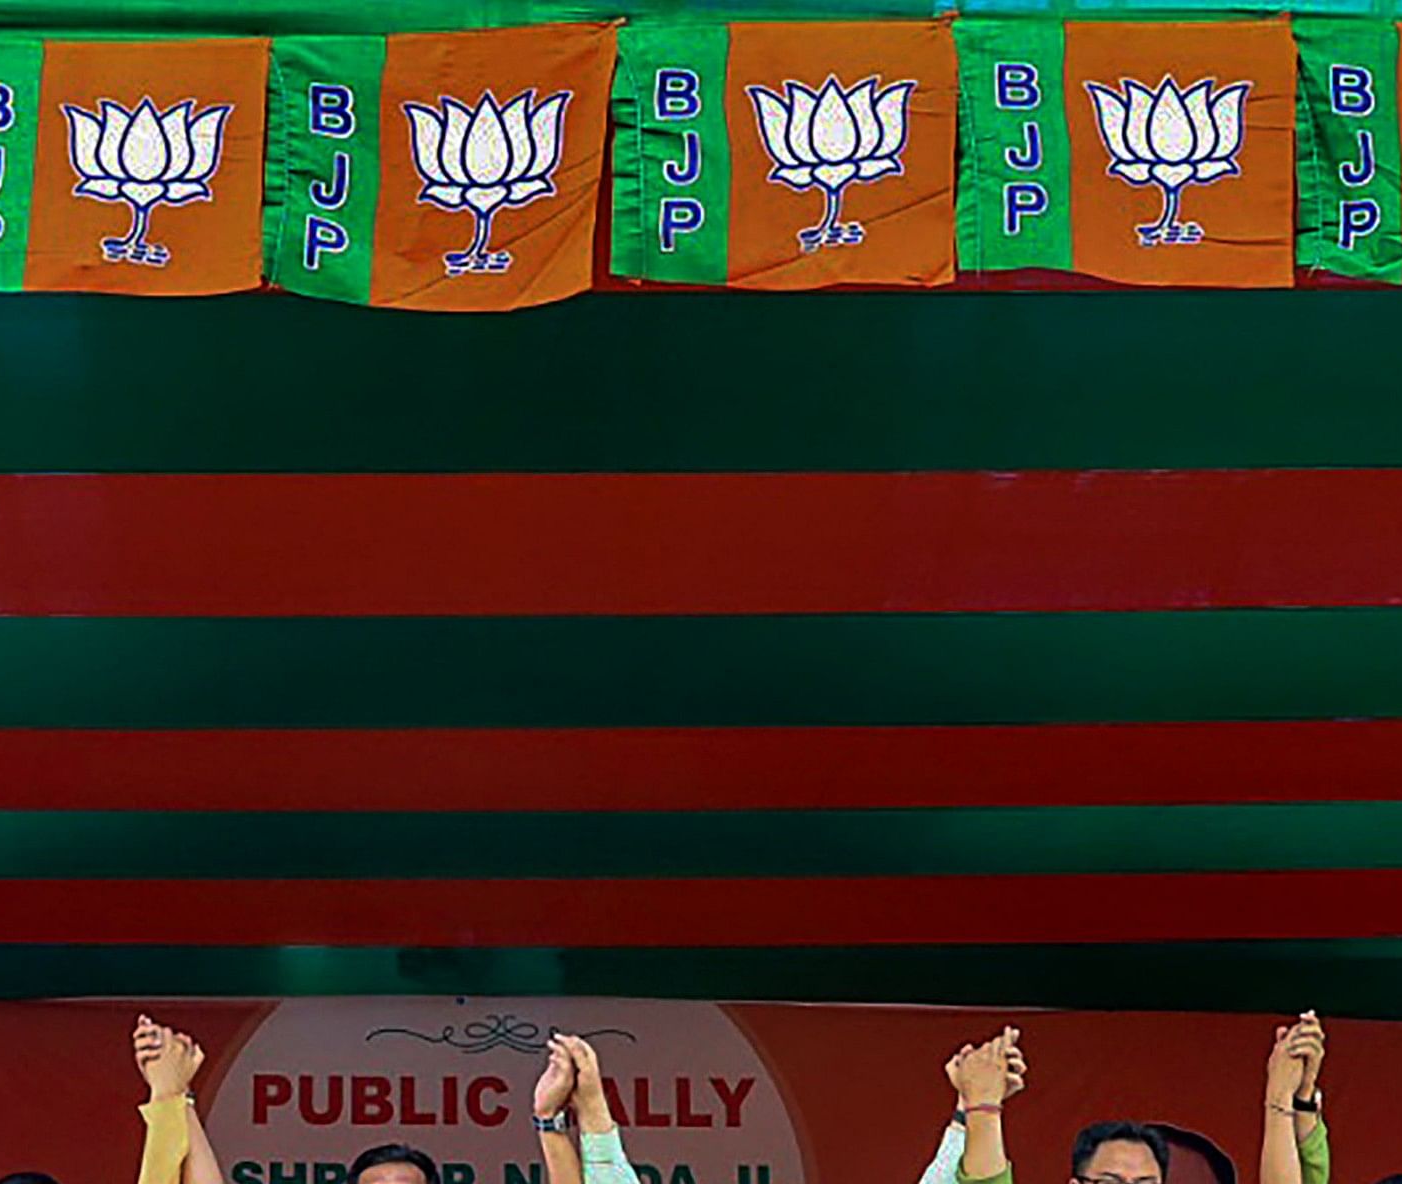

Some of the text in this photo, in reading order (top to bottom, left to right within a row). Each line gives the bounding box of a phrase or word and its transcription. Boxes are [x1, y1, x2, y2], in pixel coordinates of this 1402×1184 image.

[305, 84, 353, 269] BJP
[657, 70, 703, 249] BJP
[996, 63, 1047, 233] BJP
[1331, 65, 1379, 249] BJP
[252, 1075, 755, 1127] PUBLIC ALLY
